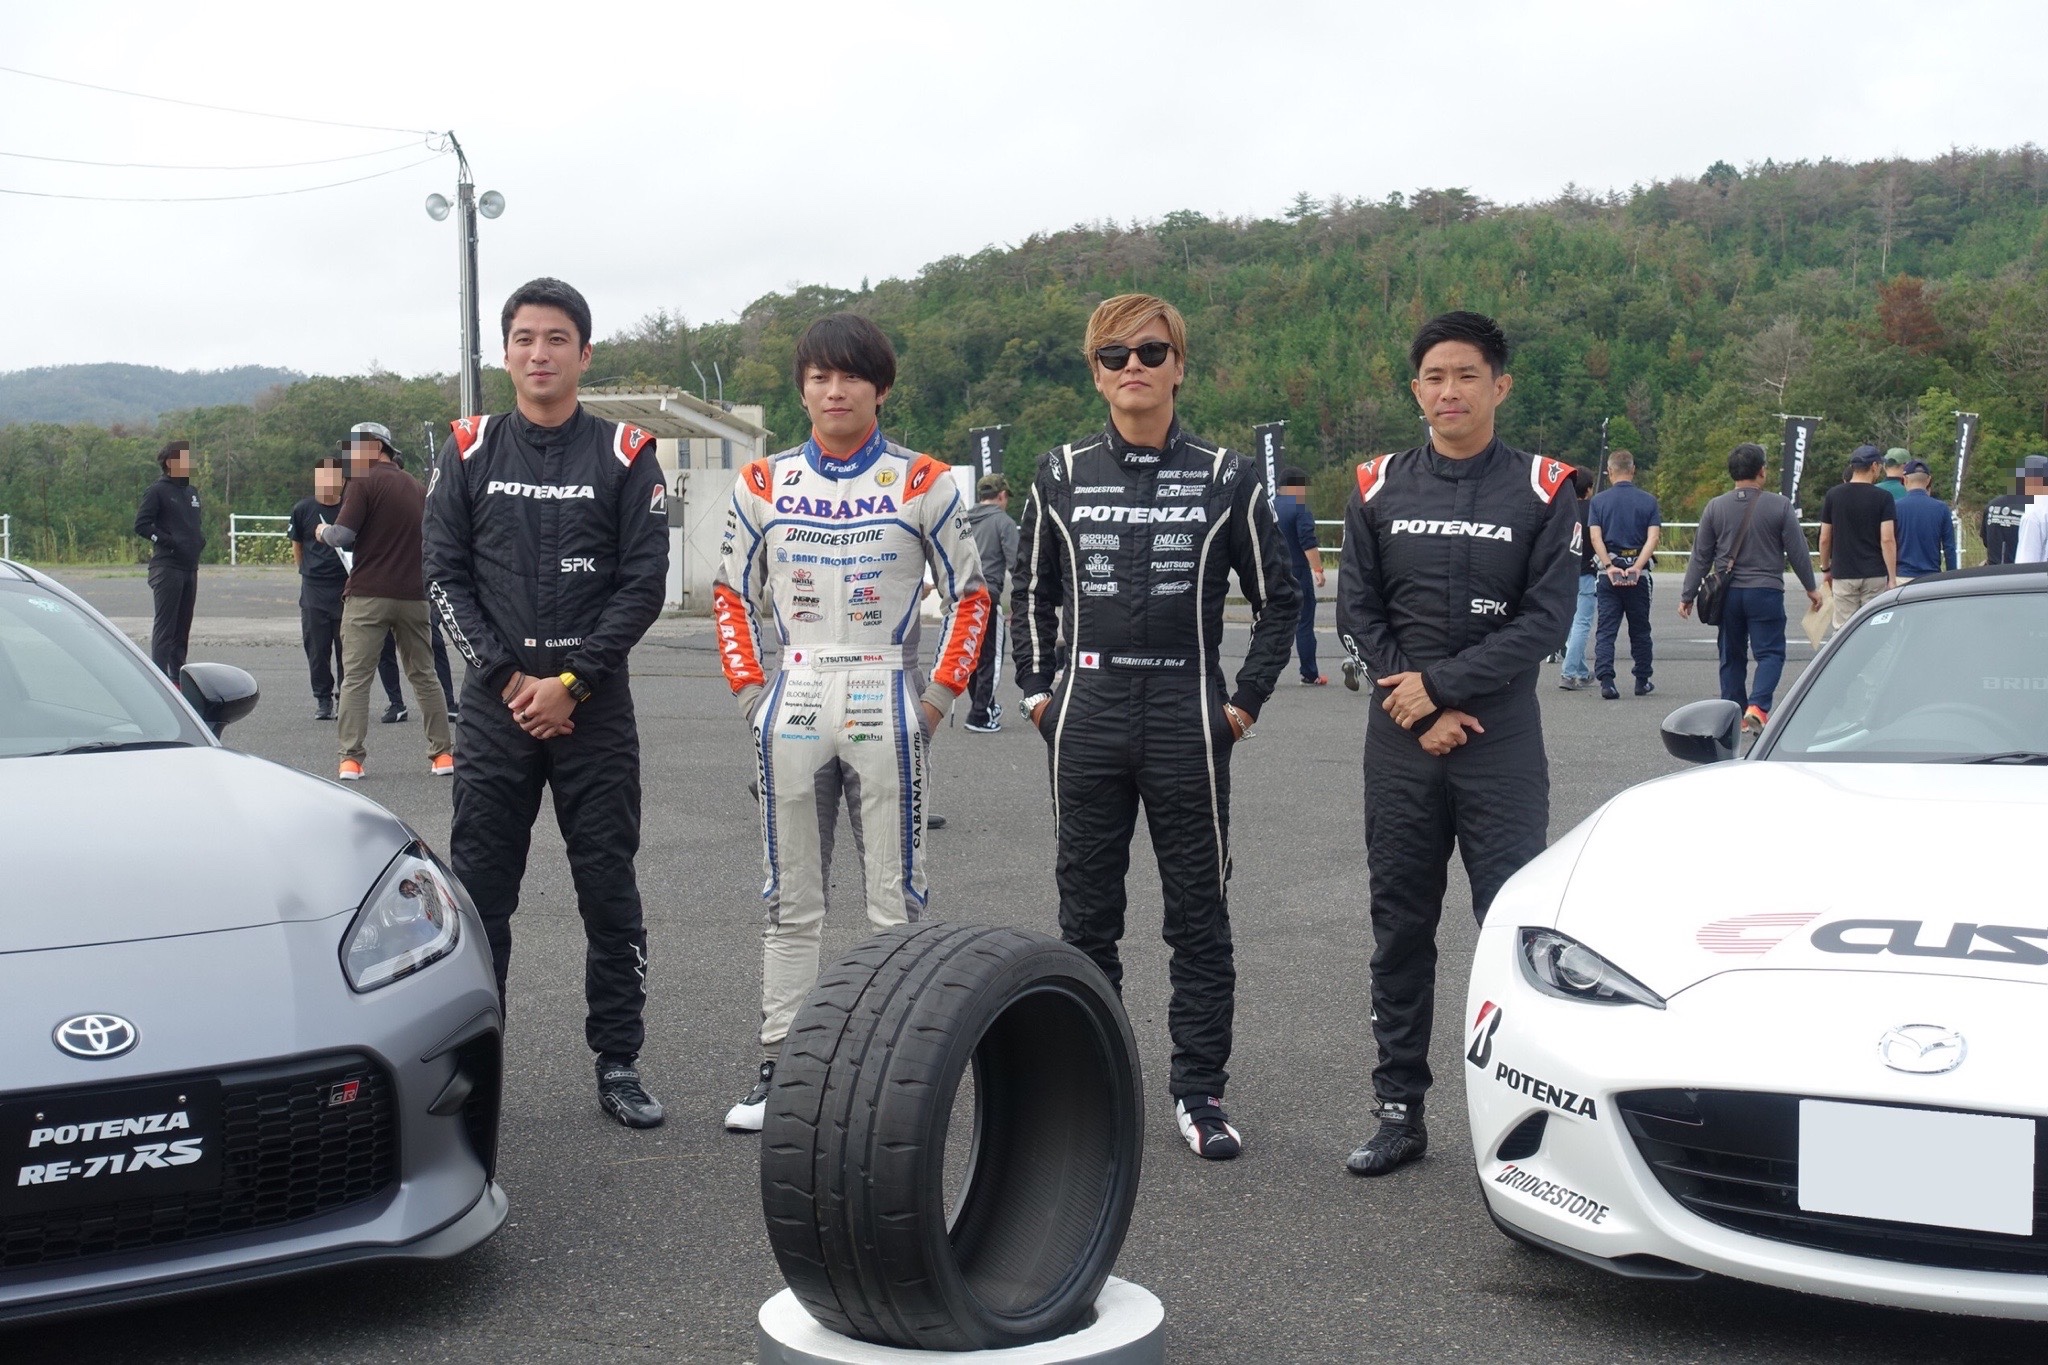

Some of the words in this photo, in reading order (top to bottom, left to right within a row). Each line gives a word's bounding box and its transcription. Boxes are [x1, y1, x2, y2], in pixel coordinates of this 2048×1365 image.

[487, 481, 595, 499] POTENZA
[1074, 486, 1126, 494] BRIDGESTONE
[775, 494, 898, 519] CABANA
[1071, 506, 1208, 523] POTENZA
[785, 528, 885, 546] BRIDGESTONE
[1153, 534, 1194, 545] ENDLESS
[1391, 519, 1512, 542] POTENZA
[561, 557, 596, 573] SPK
[844, 570, 883, 583] EXEDY
[847, 610, 882, 622] TOMEI
[1470, 598, 1507, 616] SPK
[545, 638, 582, 648] GAMOU
[715, 595, 749, 678] CABANA
[913, 778, 922, 849] CABANA
[330, 1083, 358, 1106] GR
[1495, 1061, 1598, 1121] POTENZA
[28, 1111, 190, 1148] POTENZA
[1494, 1164, 1610, 1225] BRIDGESTONE
